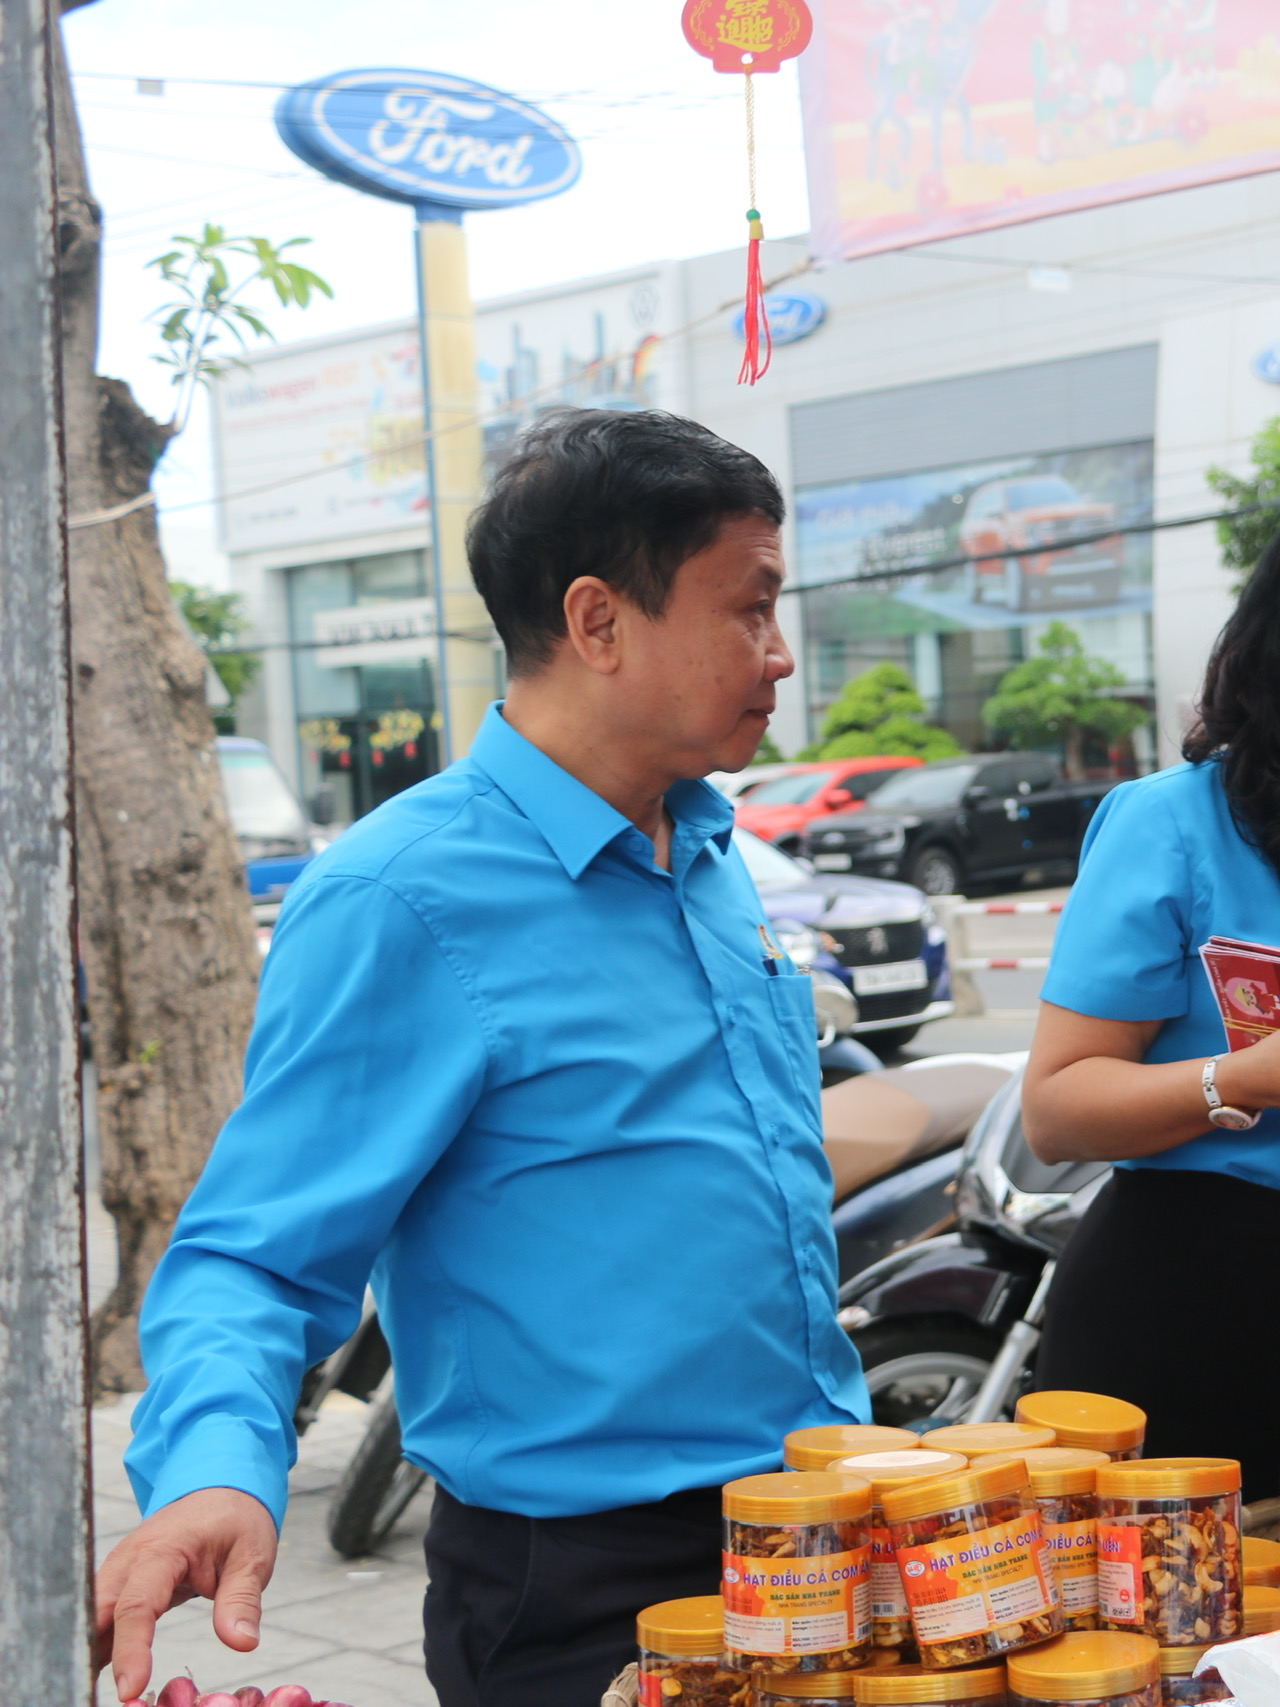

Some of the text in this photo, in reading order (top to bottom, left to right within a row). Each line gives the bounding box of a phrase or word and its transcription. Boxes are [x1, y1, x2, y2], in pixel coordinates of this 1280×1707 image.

[368, 87, 534, 187] Ford
[1076, 1532, 1093, 1547] CÁ
[929, 1554, 955, 1573] HẠT
[958, 1542, 991, 1564] ĐIỀU
[993, 1535, 1015, 1554] CÁ
[1008, 1553, 1029, 1565] TRANG
[743, 1573, 767, 1589] HẠT
[770, 1569, 802, 1587] ĐIỀU
[806, 1568, 828, 1585] CÁ
[831, 1564, 859, 1582] CƠM
[818, 1589, 841, 1598] TRANG
